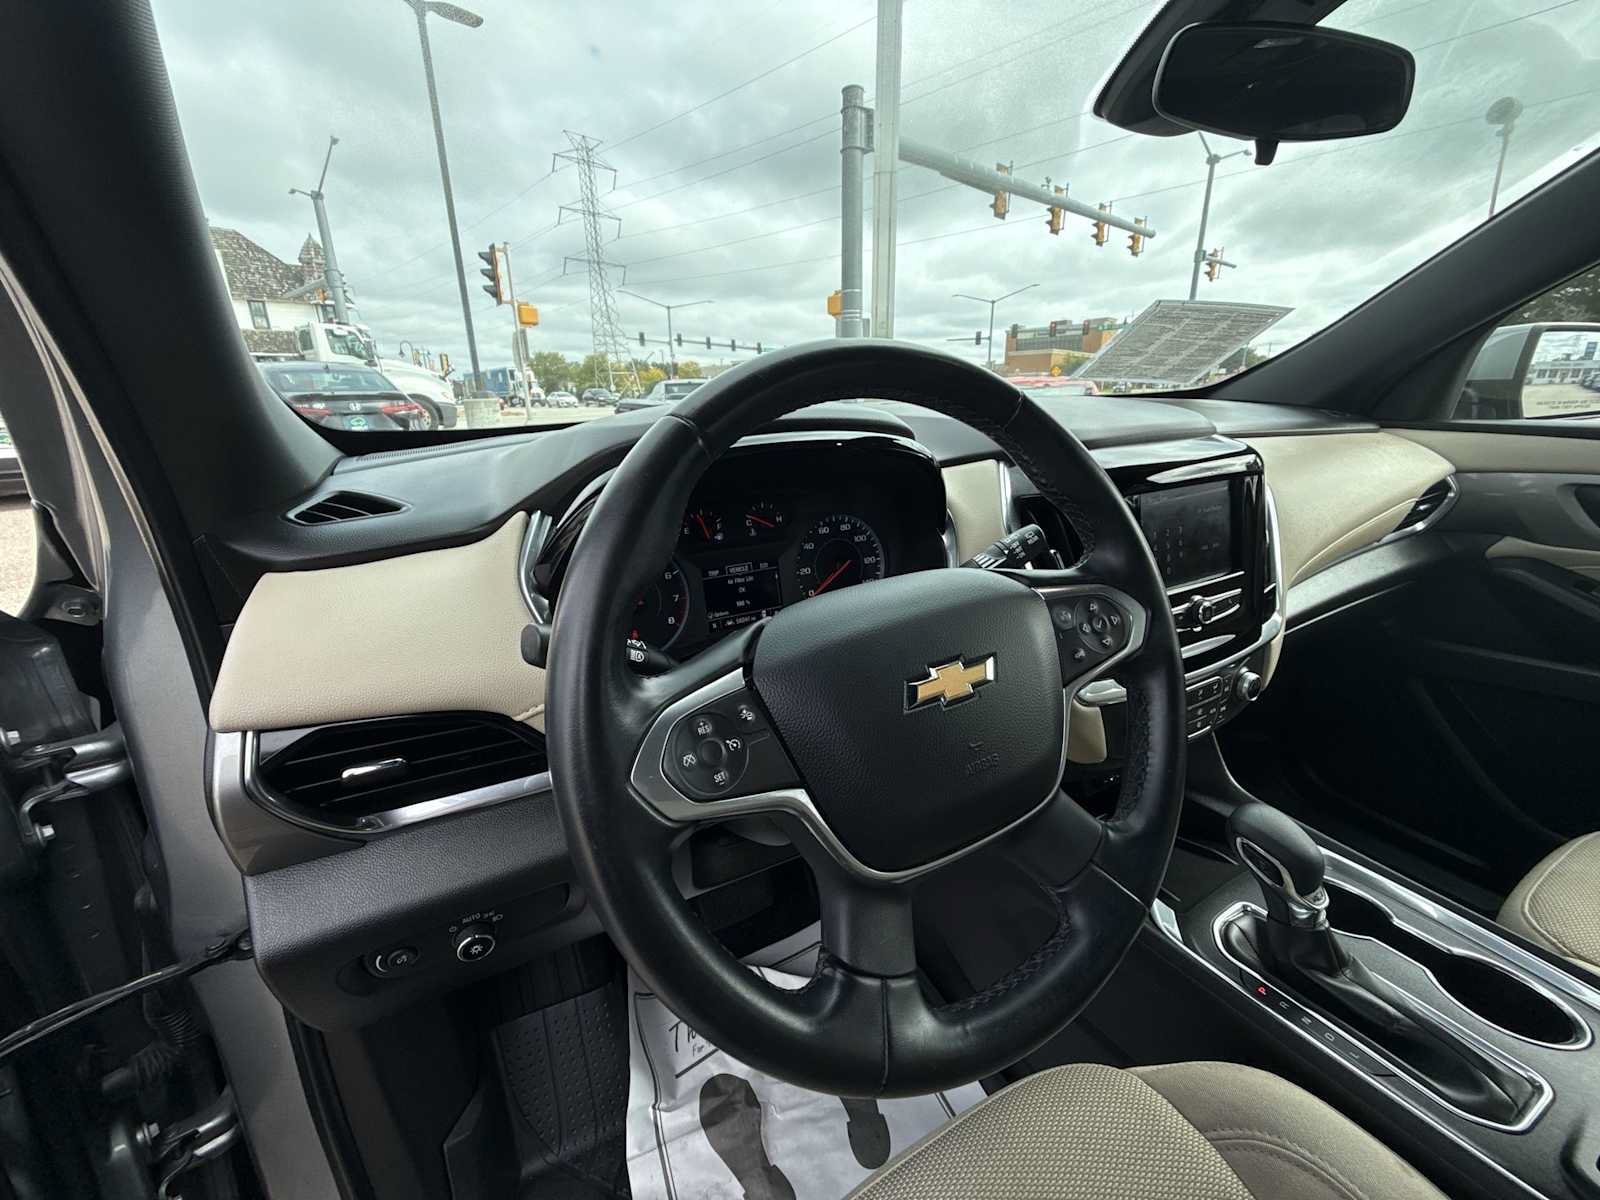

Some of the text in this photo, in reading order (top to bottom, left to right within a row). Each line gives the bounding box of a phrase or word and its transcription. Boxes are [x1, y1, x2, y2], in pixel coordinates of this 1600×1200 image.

[818, 527, 829, 535] 60
[840, 523, 851, 531] 80
[864, 556, 875, 564] 120
[800, 567, 810, 575] 20
[665, 572, 672, 580] 6
[668, 617, 675, 625] 8
[697, 726, 710, 735] RES
[713, 772, 726, 782] SET
[462, 912, 481, 924] AUTO
[1258, 986, 1266, 995] P
[1279, 1001, 1290, 1009] R
[1301, 1016, 1312, 1025] N
[1324, 1032, 1335, 1042] D
